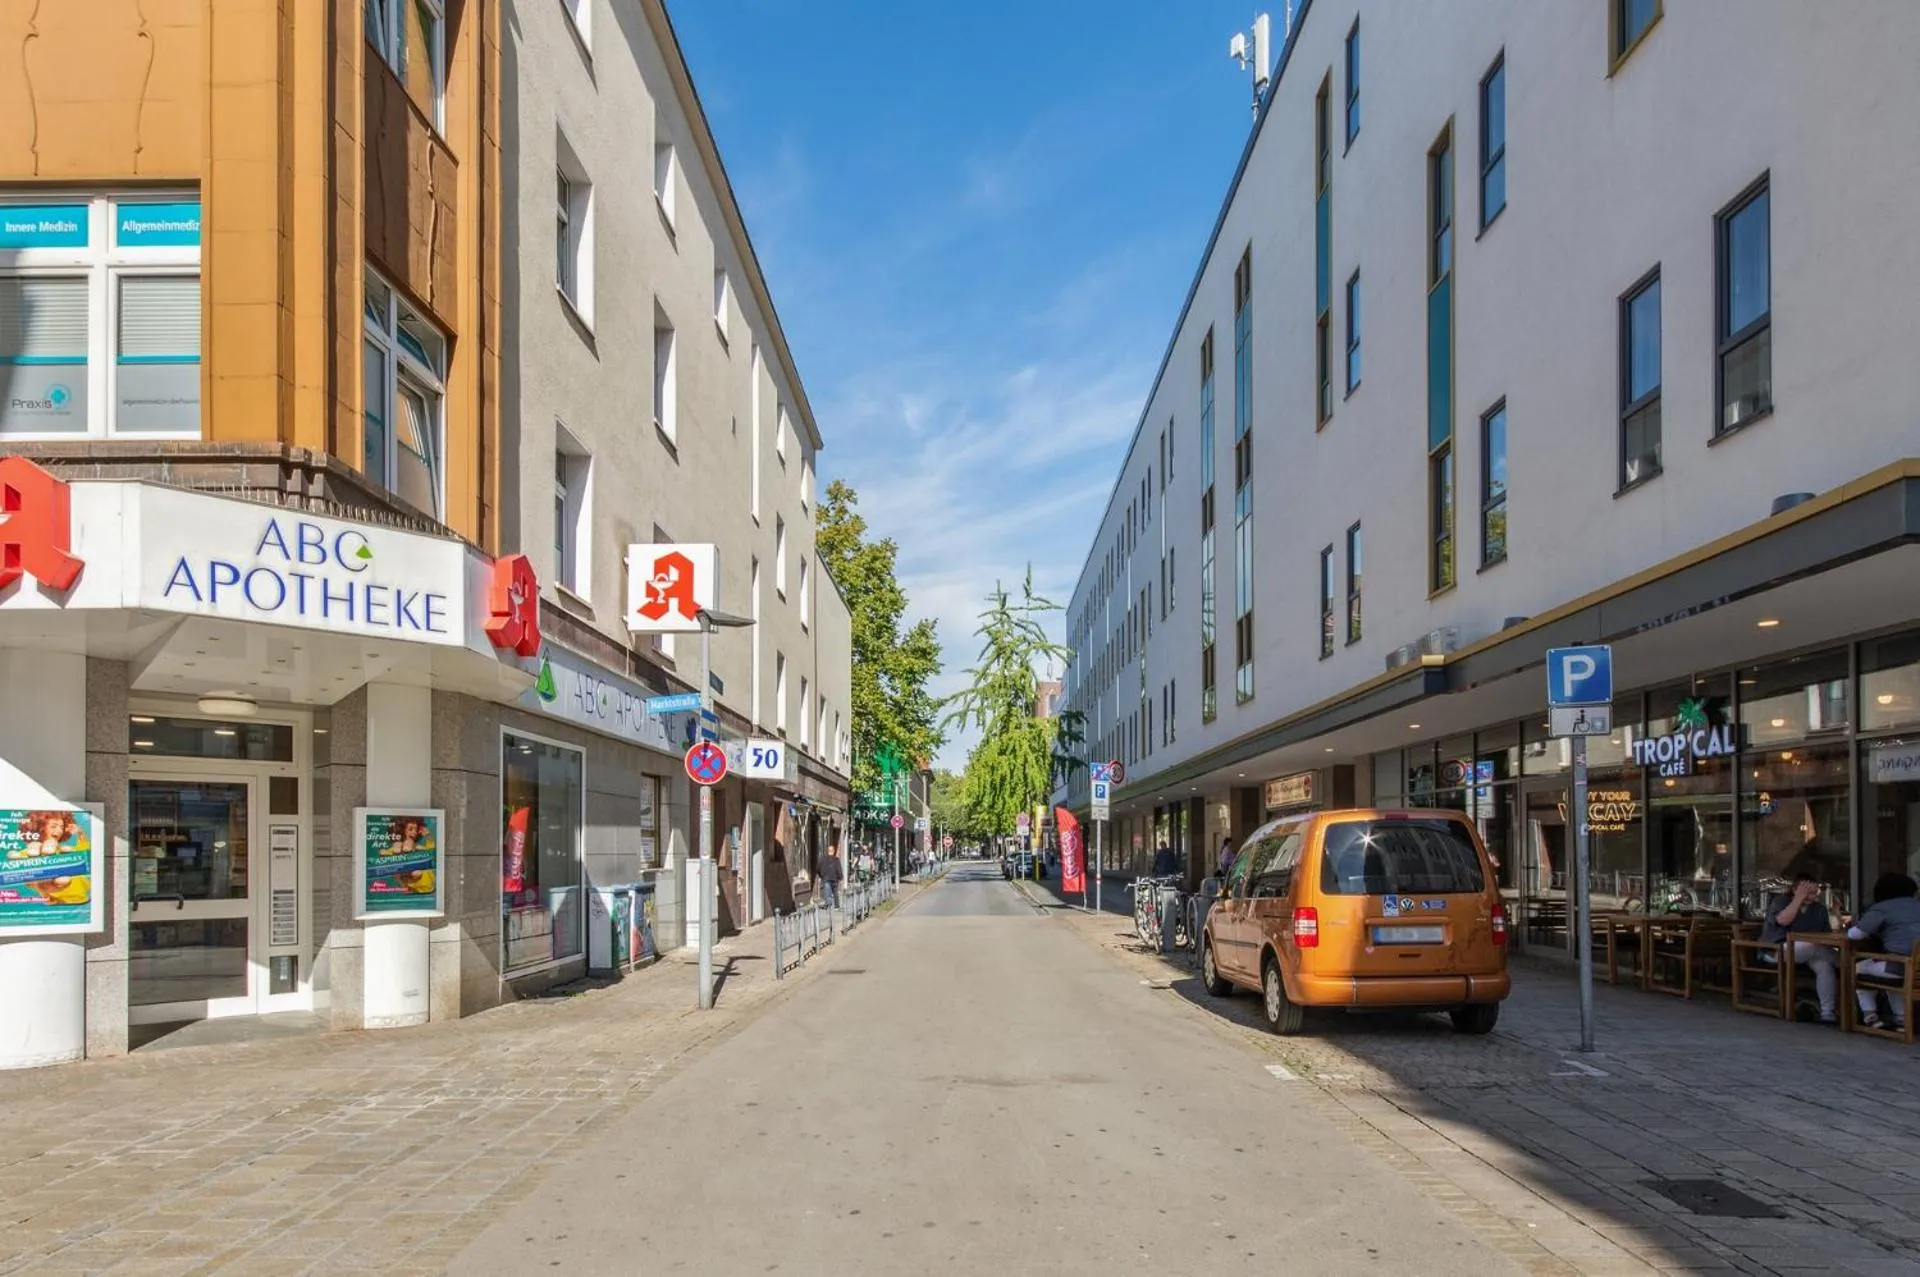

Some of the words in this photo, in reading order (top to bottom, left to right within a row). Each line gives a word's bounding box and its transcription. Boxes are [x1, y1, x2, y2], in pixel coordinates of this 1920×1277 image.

[5, 221, 36, 232] Innere
[39, 221, 77, 232] Medizin
[12, 398, 52, 409] Praxis
[256, 517, 372, 573] ABC
[163, 555, 448, 635] APOTHEKE
[1563, 655, 1596, 696] P
[574, 671, 607, 719] ABC
[1632, 724, 1736, 766] TROPICAL
[752, 747, 778, 769] 50
[1659, 758, 1685, 777] CAFÉ
[1600, 791, 1630, 801] YOUR
[1558, 803, 1636, 821] VCAY
[366, 832, 402, 840] direkte
[2, 857, 47, 869] ASPIRIN
